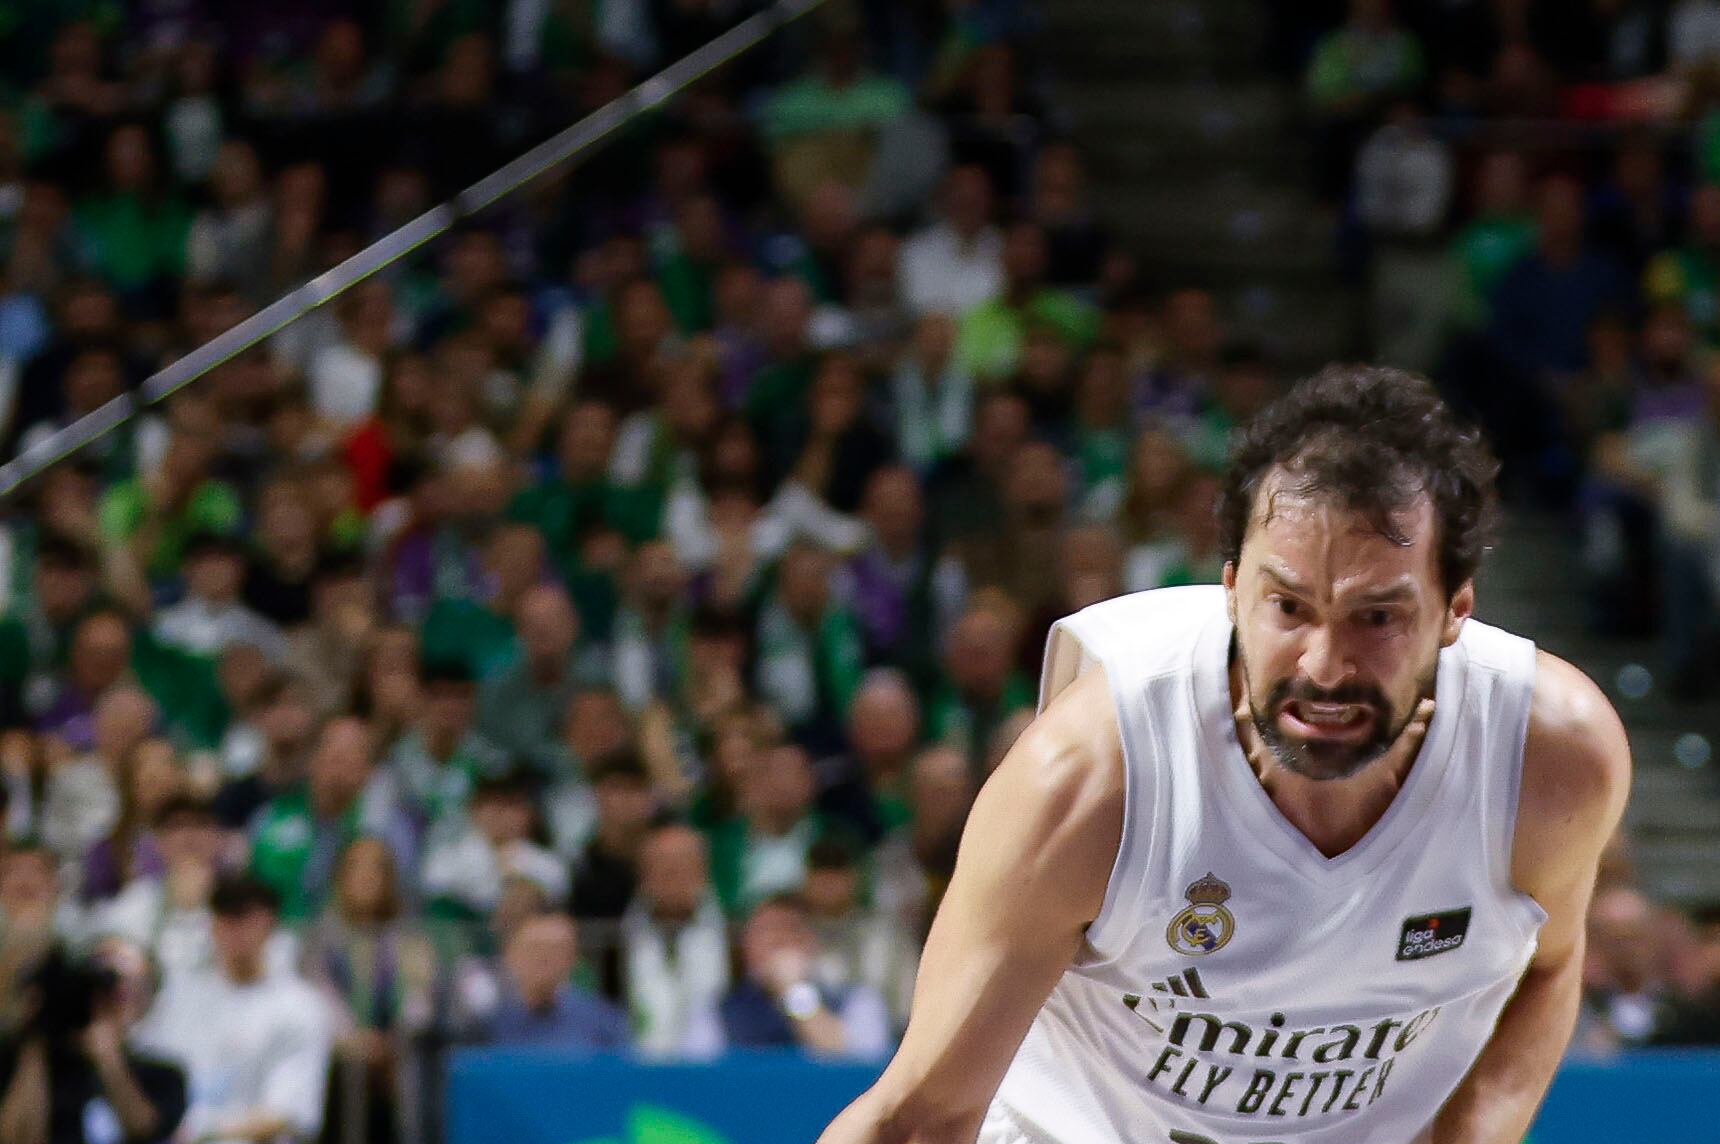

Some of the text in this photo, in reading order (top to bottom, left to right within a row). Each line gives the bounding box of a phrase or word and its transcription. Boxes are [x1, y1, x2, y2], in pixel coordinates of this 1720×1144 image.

[1403, 935, 1462, 955] endesa
[1406, 929, 1433, 943] liga
[1147, 1046, 1395, 1116] FLY BETTER
